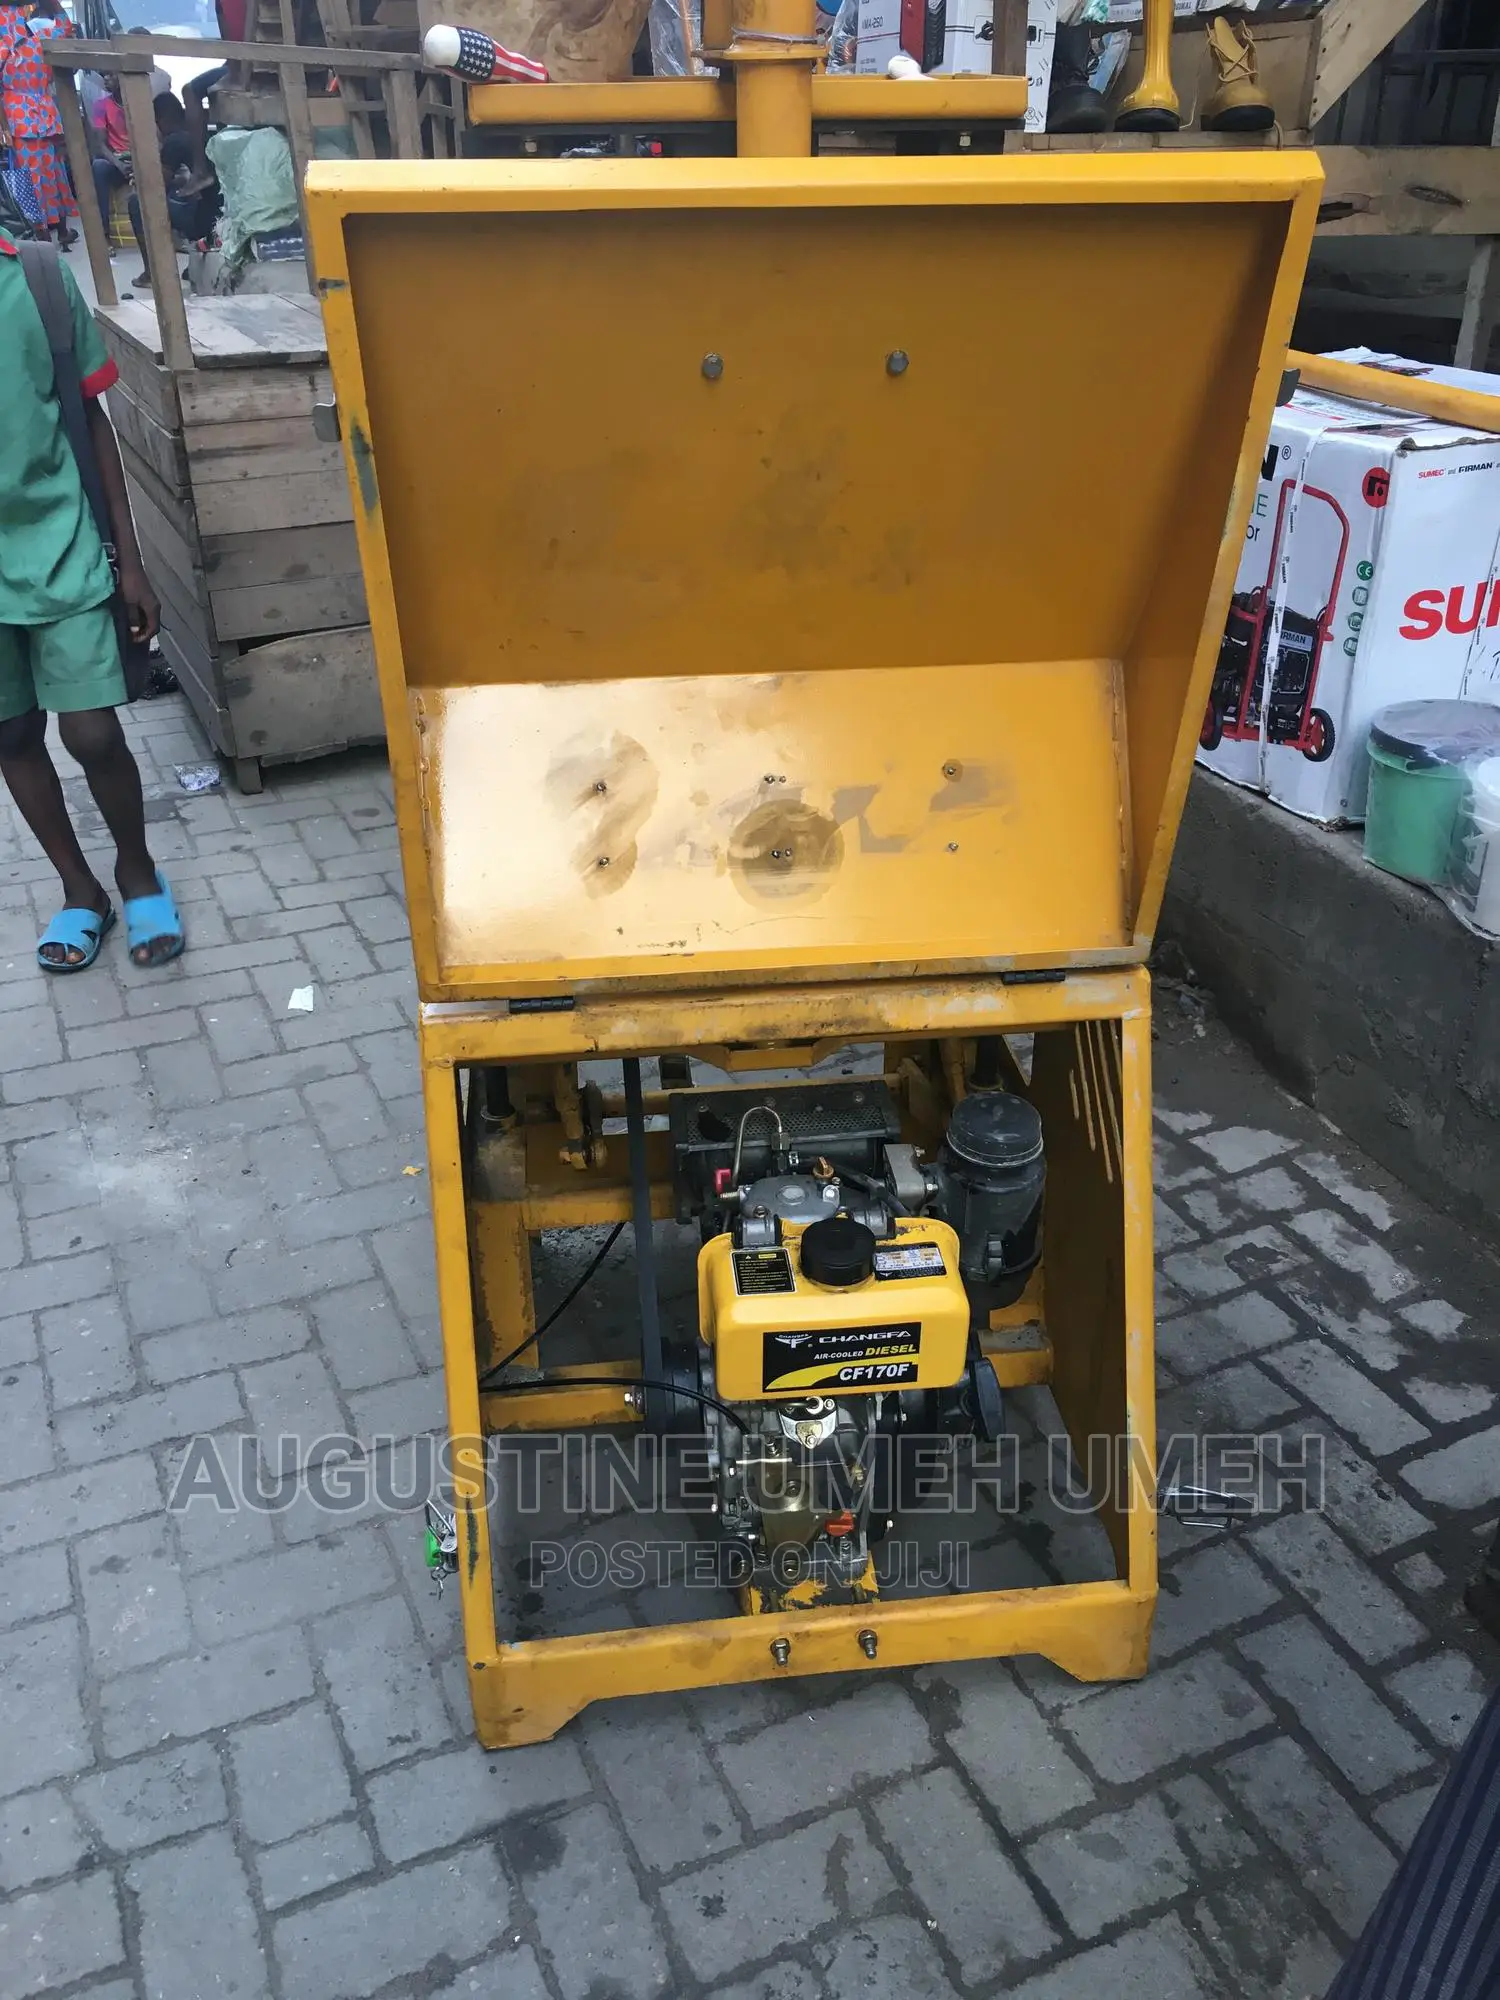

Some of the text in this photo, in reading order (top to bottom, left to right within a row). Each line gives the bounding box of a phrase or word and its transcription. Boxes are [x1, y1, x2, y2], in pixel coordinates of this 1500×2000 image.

[1418, 468, 1445, 479] SUMEC
[1458, 461, 1494, 474] FIRMAN
[1280, 631, 1306, 645] IRMAN
[818, 1330, 912, 1344] CHANGFA
[814, 1343, 917, 1360] AIR-COOLED DIESEL
[839, 1363, 910, 1381] CF170F
